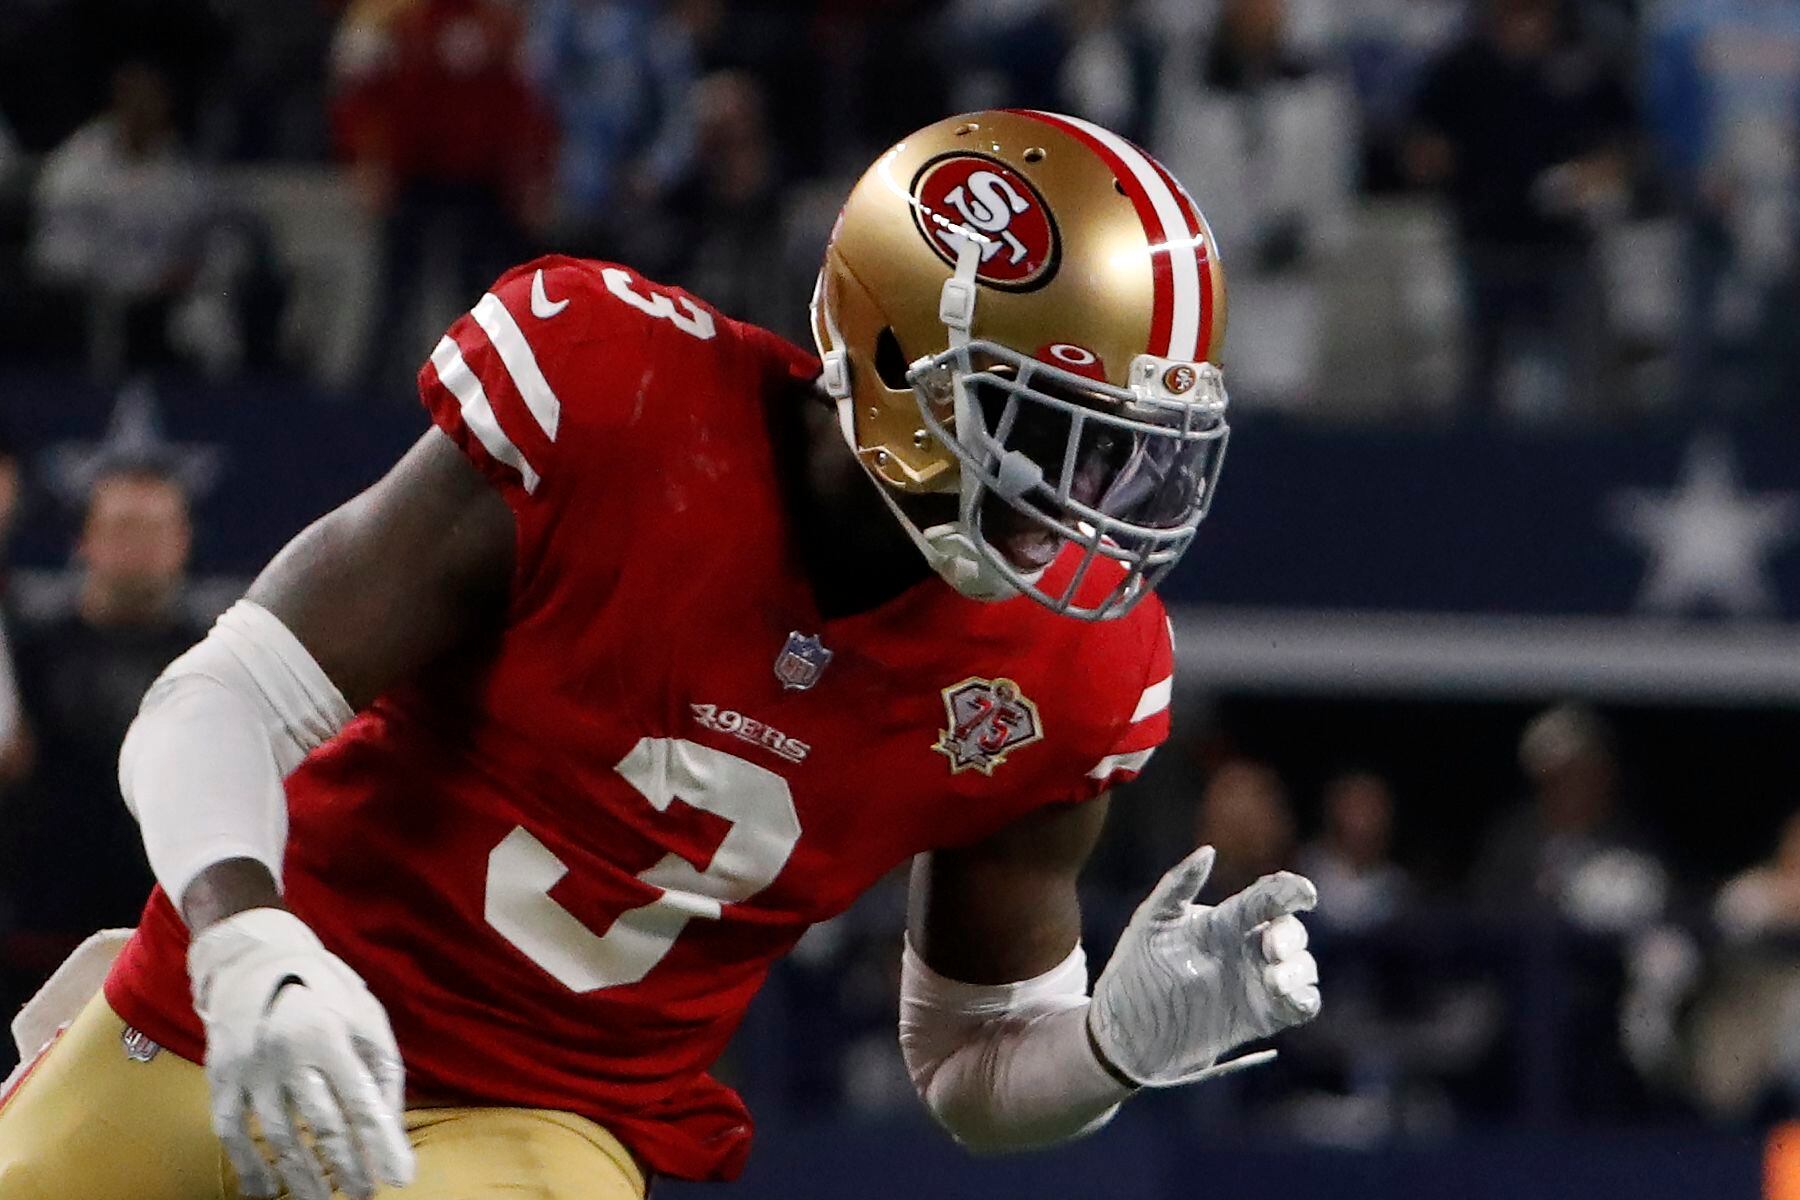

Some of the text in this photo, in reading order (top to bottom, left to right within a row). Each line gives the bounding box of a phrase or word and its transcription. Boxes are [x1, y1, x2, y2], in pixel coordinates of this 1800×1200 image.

[602, 268, 716, 340] 3
[690, 703, 811, 763] 49ERS
[955, 696, 1019, 751] 75
[484, 737, 802, 993] 3
